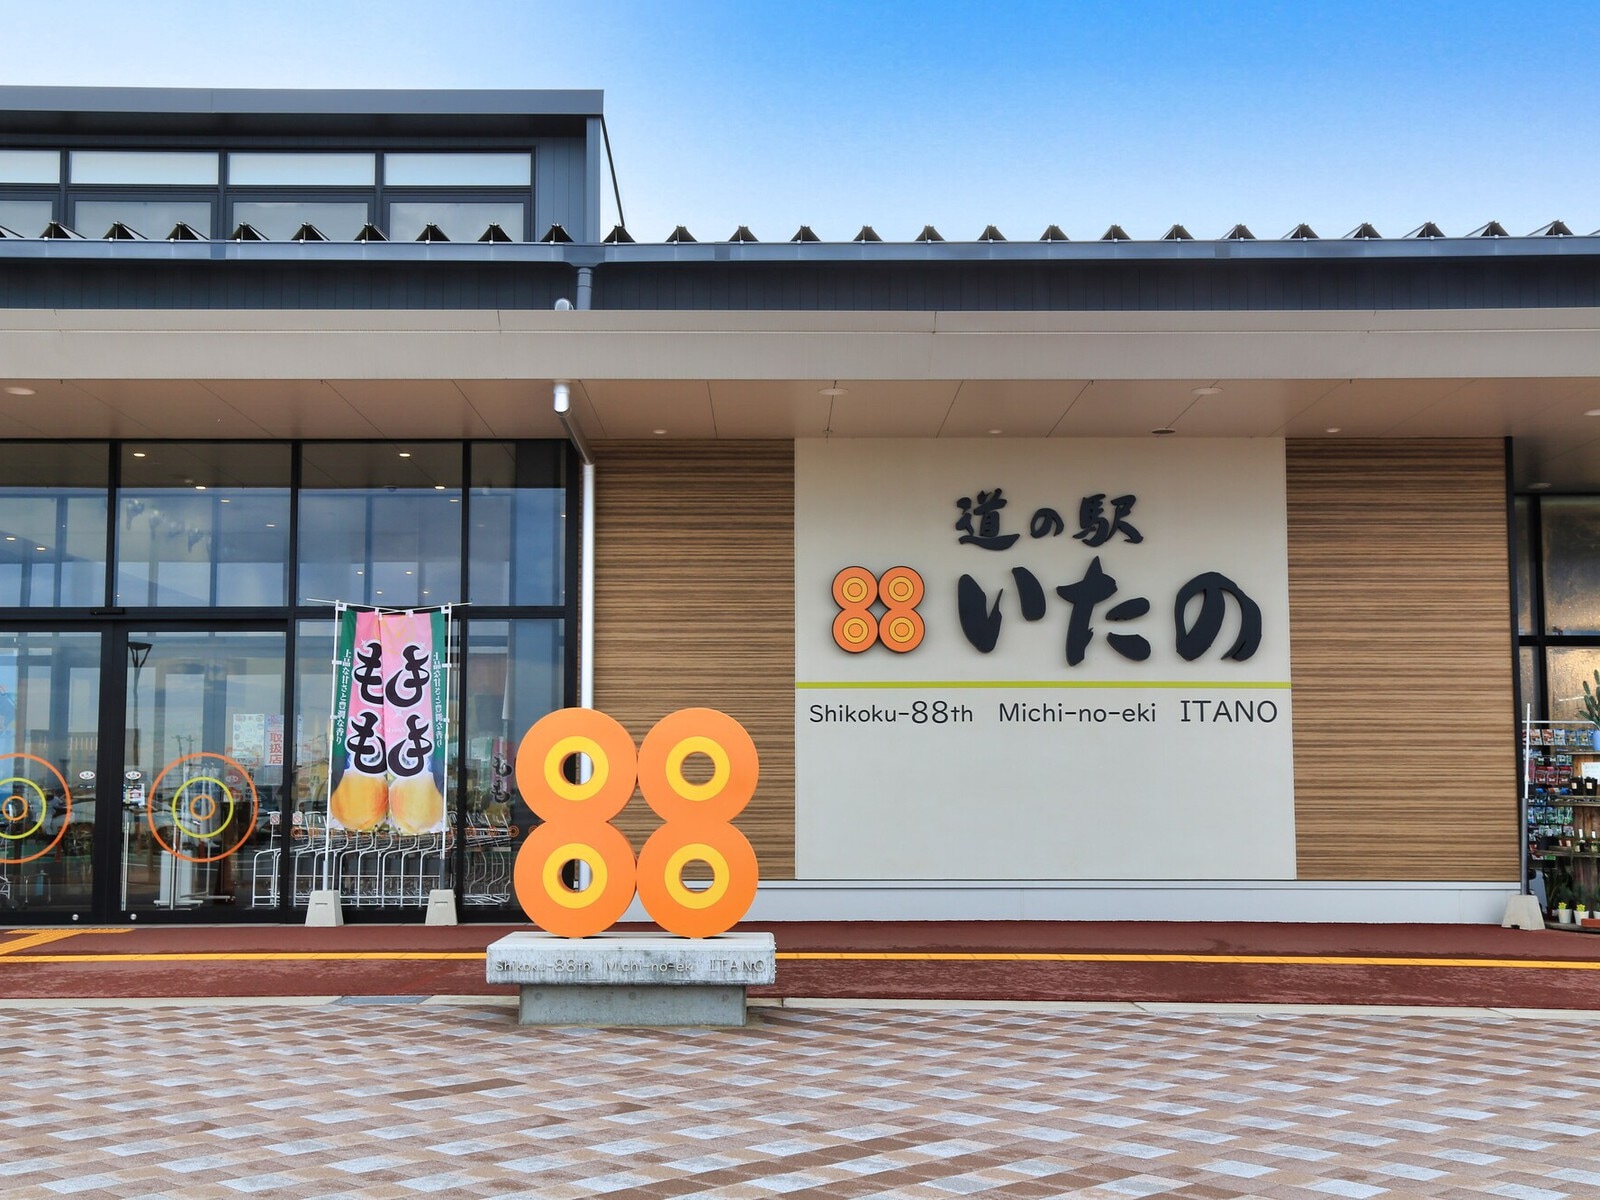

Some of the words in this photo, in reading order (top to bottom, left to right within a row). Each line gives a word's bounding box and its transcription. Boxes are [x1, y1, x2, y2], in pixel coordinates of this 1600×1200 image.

[955, 487, 1144, 551] 道の駅
[957, 555, 1263, 667] いたの
[809, 700, 973, 724] Shikoku-88th
[999, 702, 1156, 723] Michi-no-eki
[1180, 700, 1278, 723] ITANO
[269, 732, 283, 765] 取扱店
[709, 959, 765, 973] ITANO
